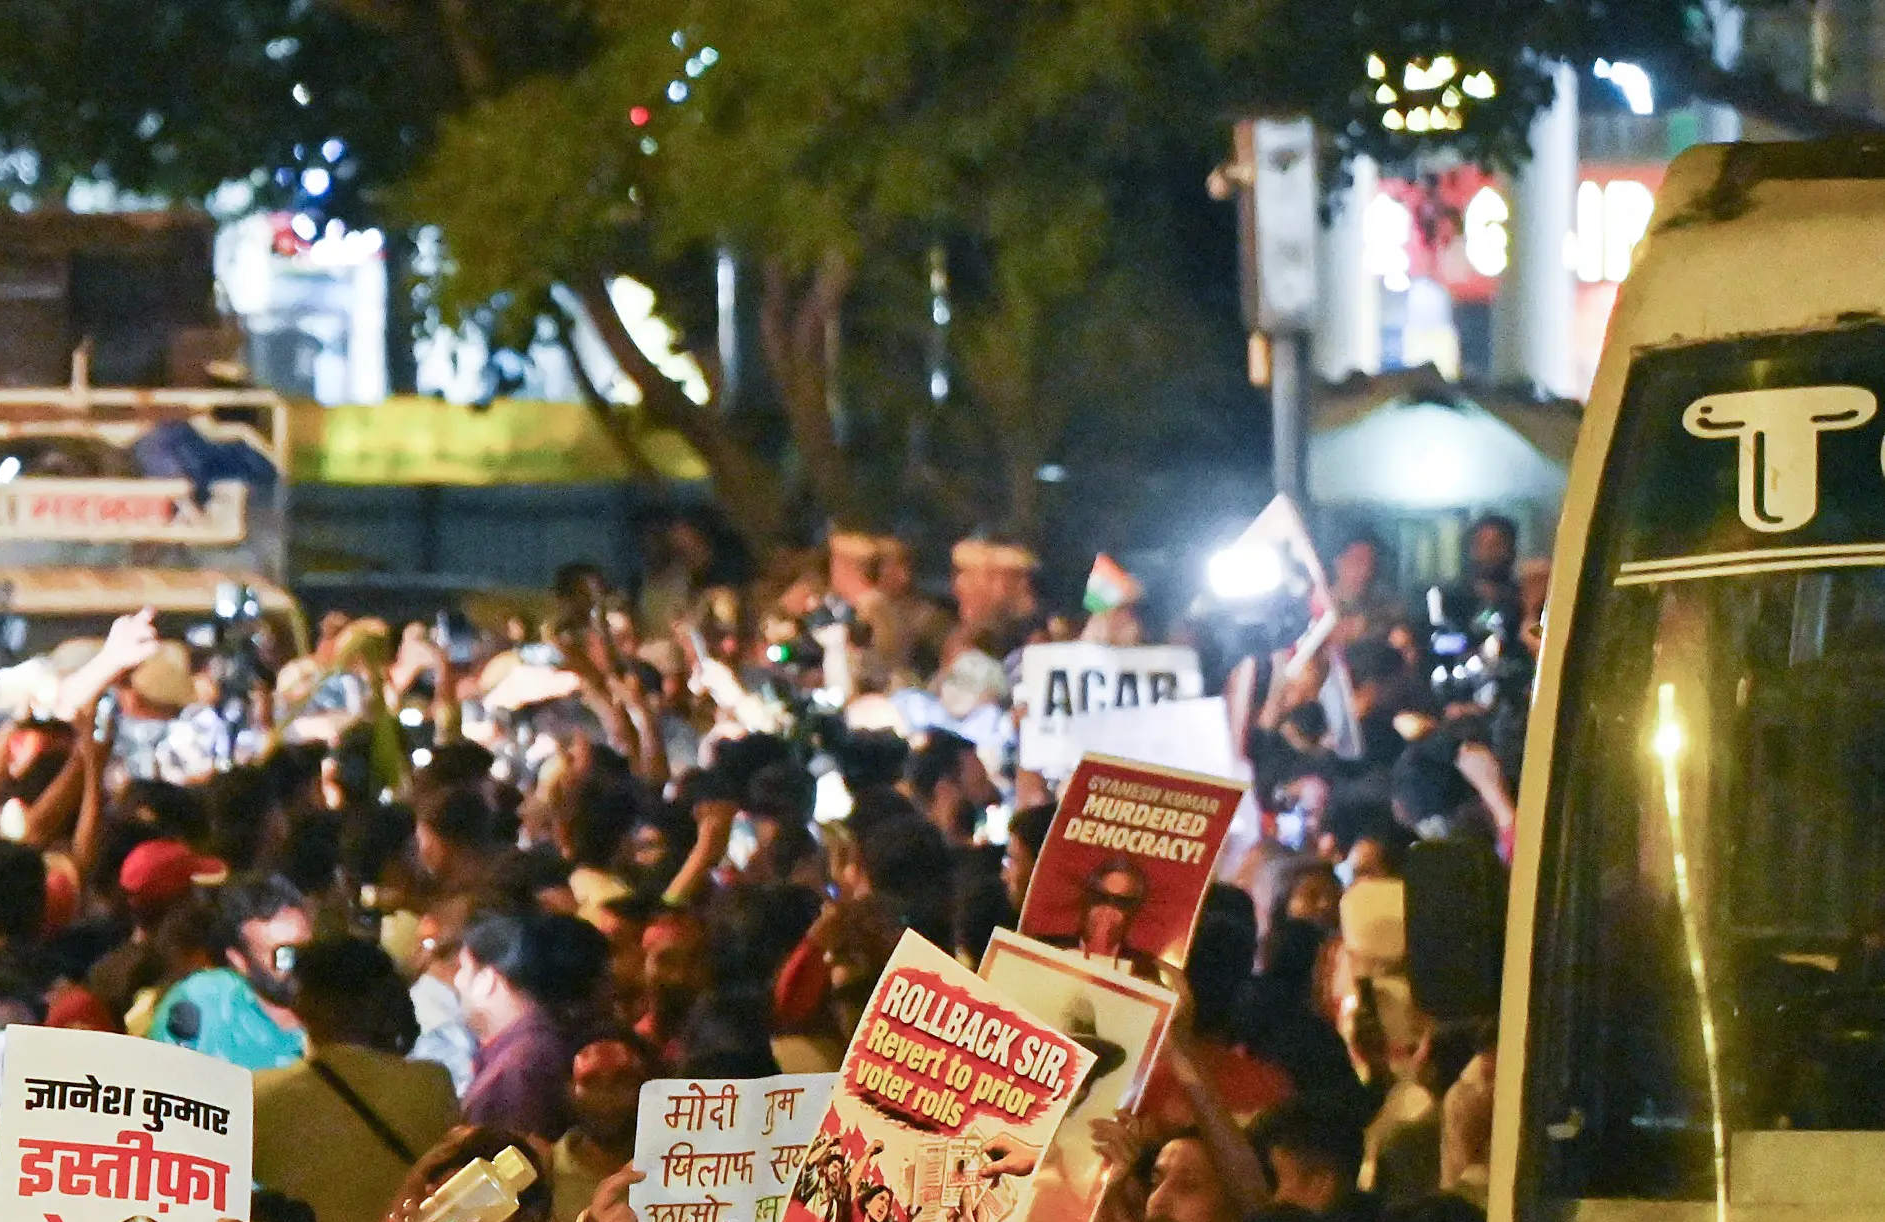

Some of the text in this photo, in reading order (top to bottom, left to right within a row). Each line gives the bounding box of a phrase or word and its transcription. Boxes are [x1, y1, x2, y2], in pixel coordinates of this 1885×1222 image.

[1682, 384, 1885, 533] T
[1063, 817, 1207, 865] DEMOCRACY!
[1081, 793, 1208, 838] MURDERED
[866, 1018, 1037, 1118] Revert to prior
[881, 975, 1068, 1101] ROLLBACK SIR,
[25, 1074, 231, 1135] ज्ञानेश कुमार
[664, 1082, 739, 1132] मोदी
[855, 1058, 966, 1128] voter rolls
